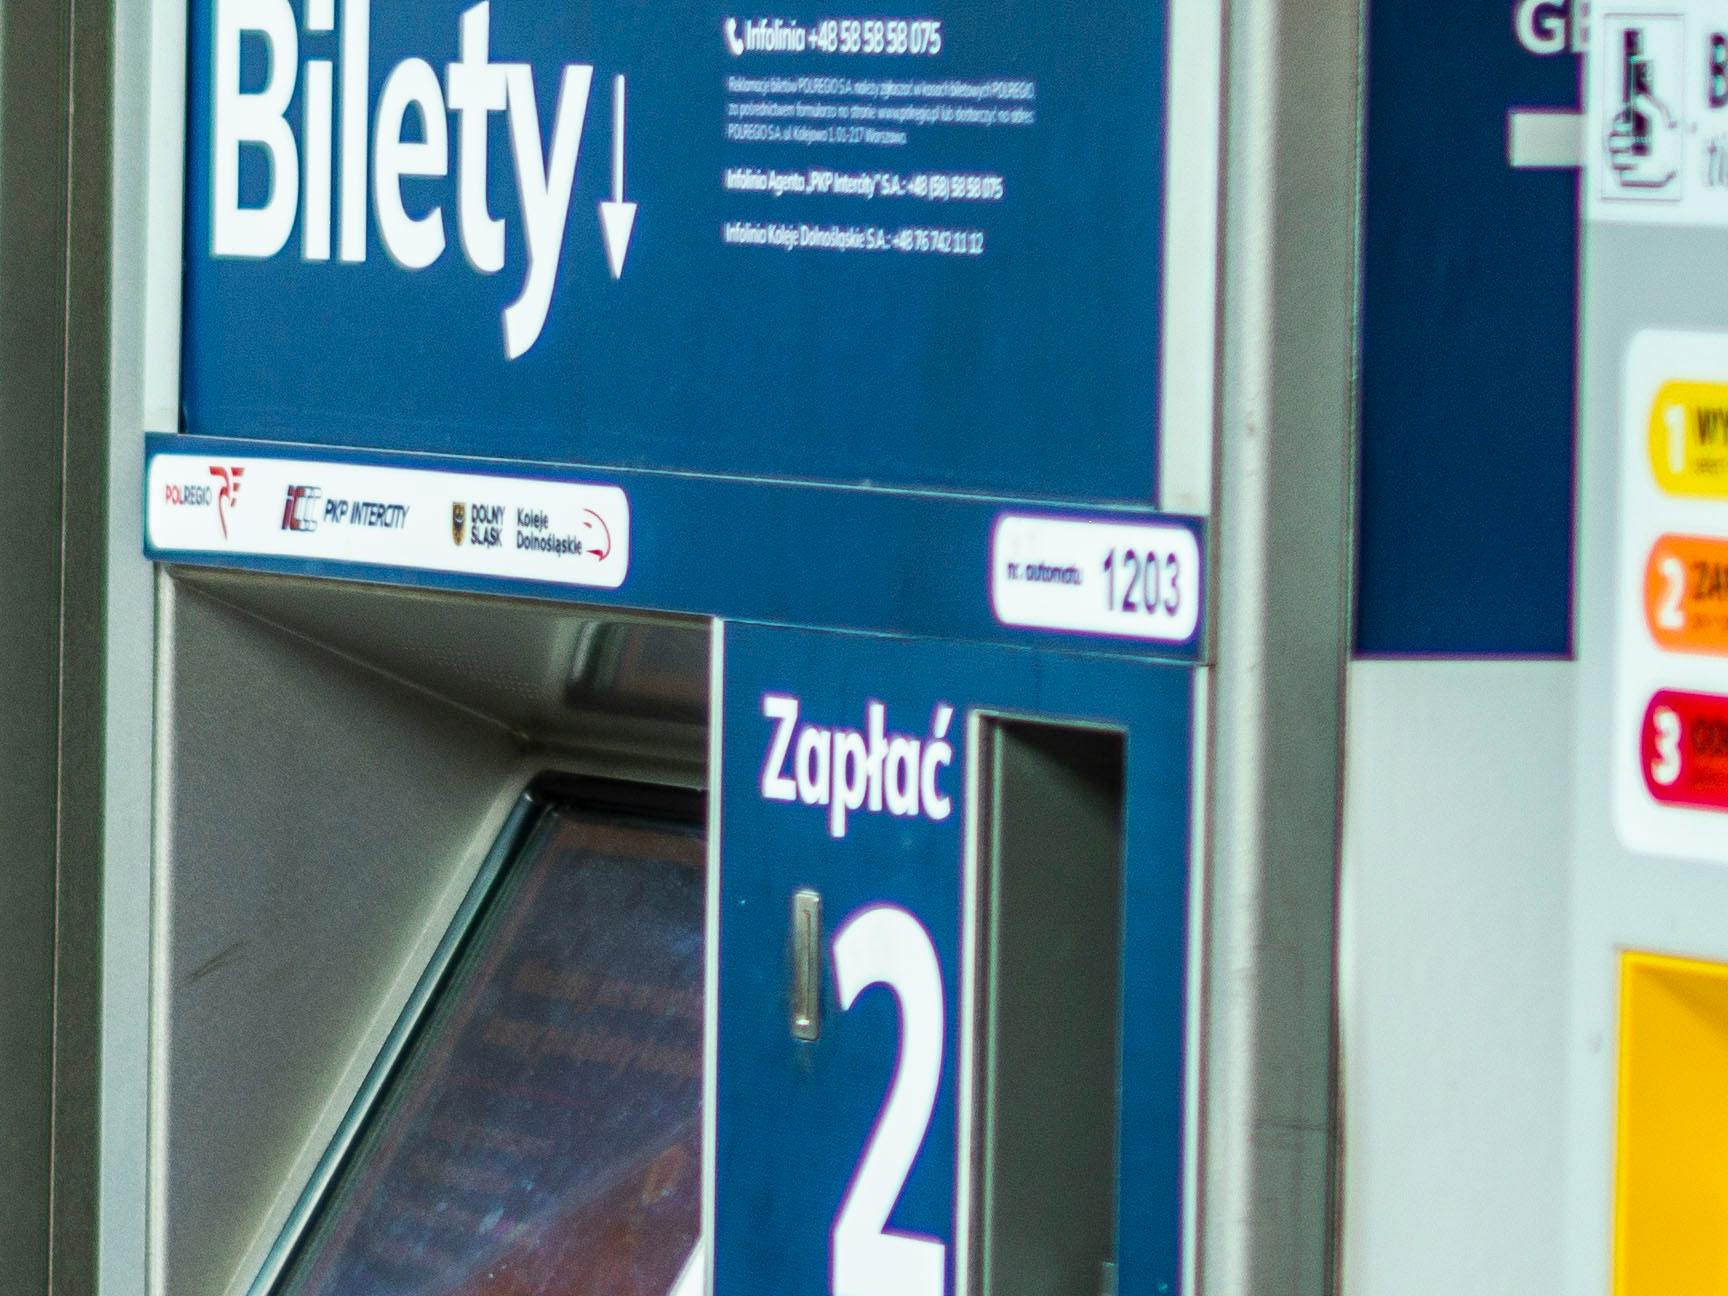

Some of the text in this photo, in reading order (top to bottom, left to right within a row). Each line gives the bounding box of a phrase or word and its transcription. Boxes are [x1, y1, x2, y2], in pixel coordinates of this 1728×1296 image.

[744, 17, 942, 54] Infolinia +48 58 58 58 075
[211, 0, 593, 360] Bilety
[1664, 404, 1686, 474] 1
[165, 484, 213, 506] POLREGIO
[323, 498, 411, 530] PKP INTERCITY
[471, 503, 505, 526] DOLNY
[516, 506, 549, 533] Koleje
[470, 524, 503, 549] ŚLĄSK
[516, 529, 583, 558] Dolnośląskie
[1103, 547, 1182, 617] 1203
[1657, 556, 1686, 629] 2
[1651, 704, 1684, 786] 3
[761, 694, 954, 838] Zapłać
